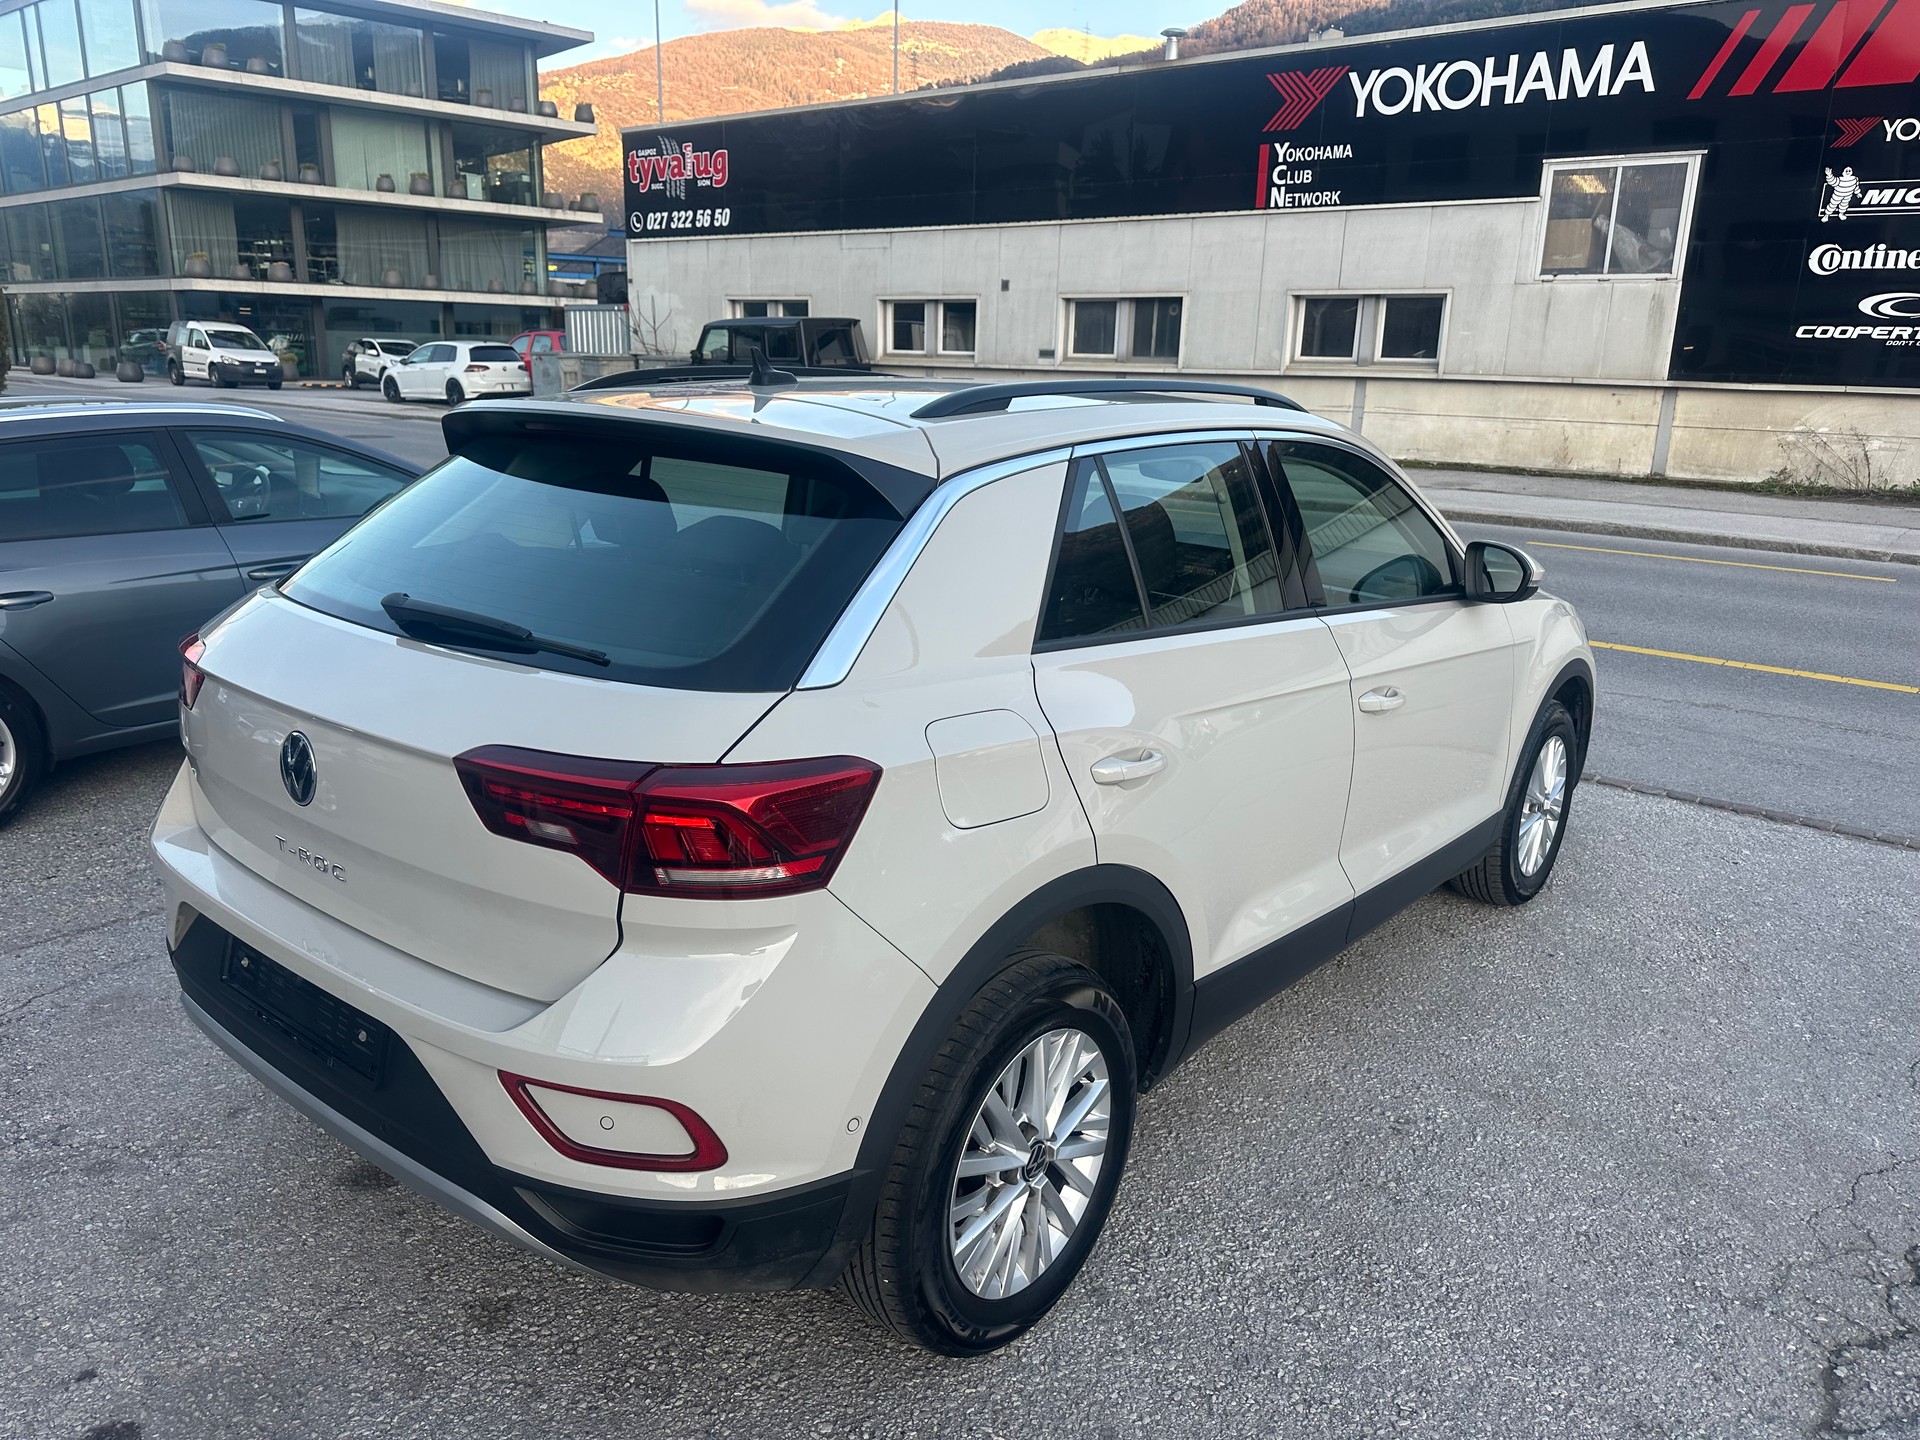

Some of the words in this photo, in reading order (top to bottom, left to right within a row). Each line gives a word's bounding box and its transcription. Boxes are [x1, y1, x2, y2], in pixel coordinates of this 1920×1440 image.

[1349, 40, 1656, 118] YOKOHAMA
[628, 143, 728, 193] tyvalug
[646, 211, 668, 231] 027
[670, 210, 693, 229] 322
[695, 209, 711, 228] 56
[714, 207, 731, 227] 50
[1808, 243, 1920, 275] Contine
[274, 834, 347, 882] T-ROC
